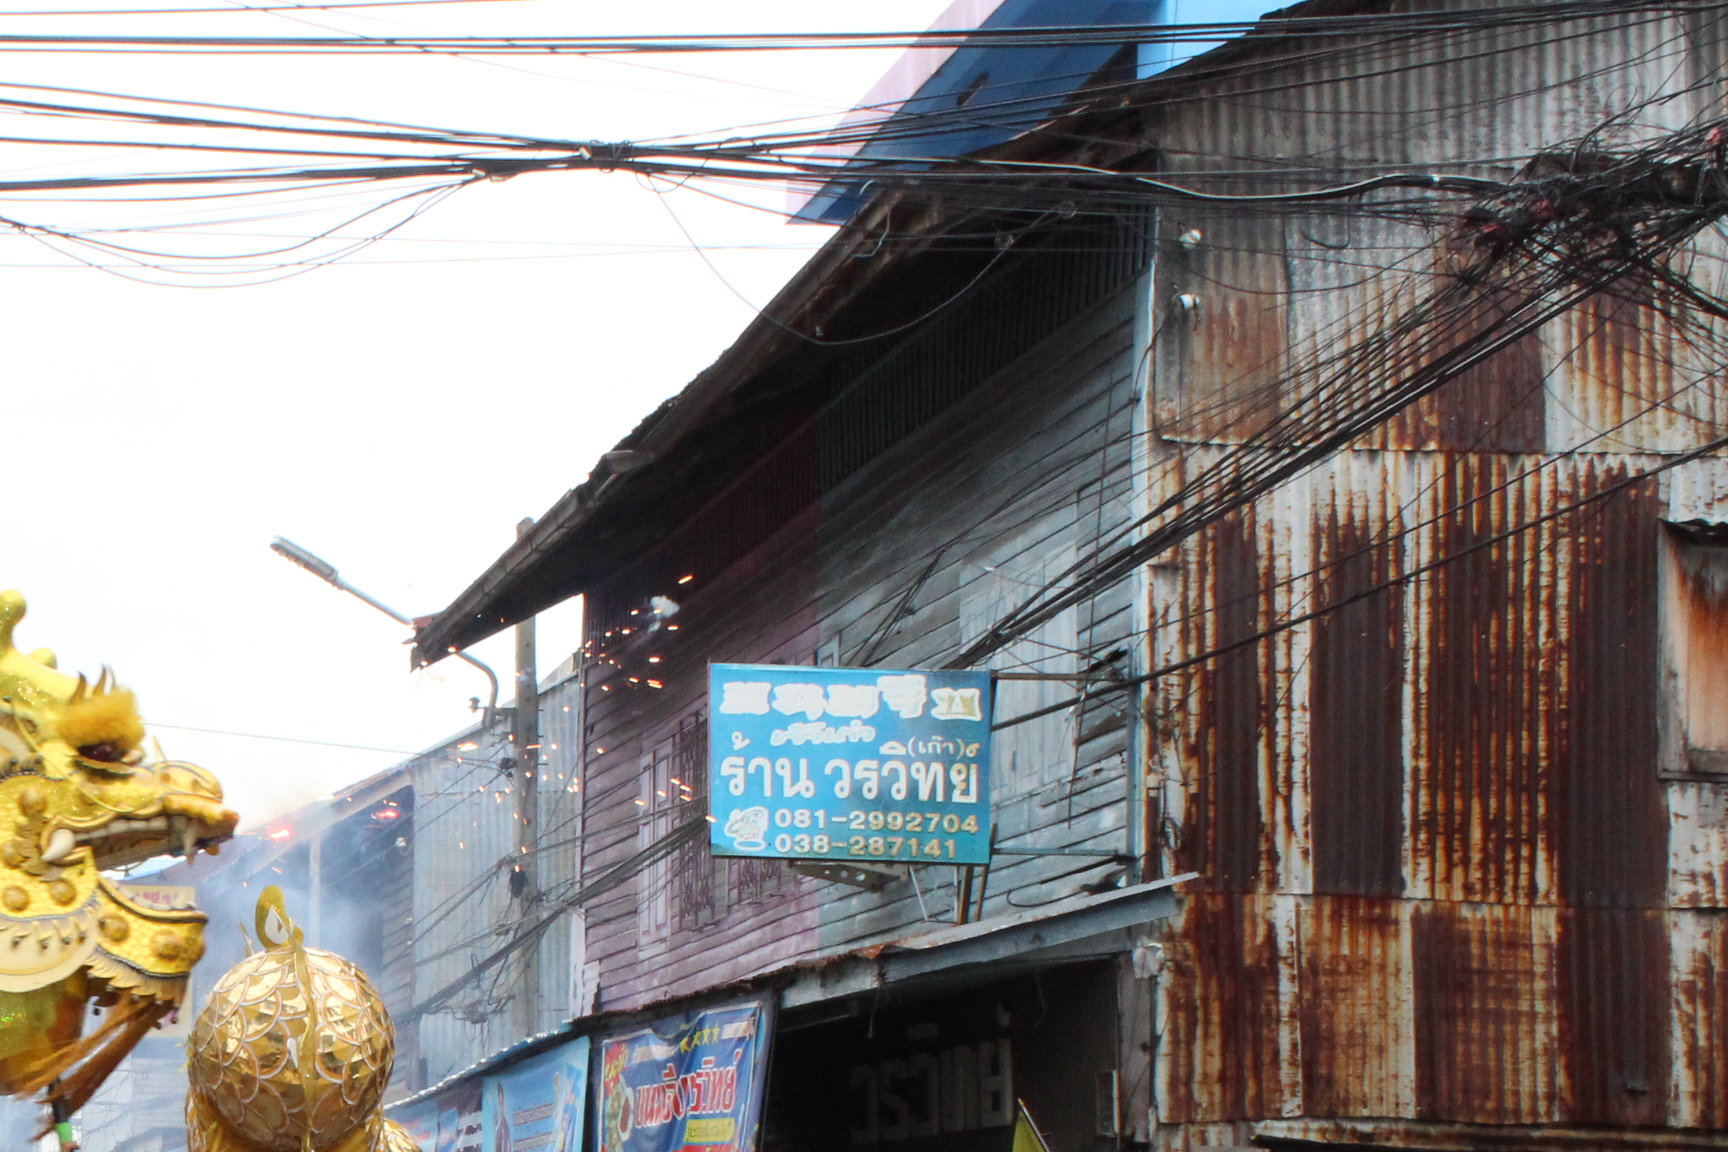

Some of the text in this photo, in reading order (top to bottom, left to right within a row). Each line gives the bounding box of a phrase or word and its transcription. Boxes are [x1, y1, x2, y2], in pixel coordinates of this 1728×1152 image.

[719, 730, 816, 798] ร้าน
[824, 740, 982, 804] วรวิทย์
[774, 808, 980, 835] 081-2992704
[774, 833, 956, 859] 038-287141
